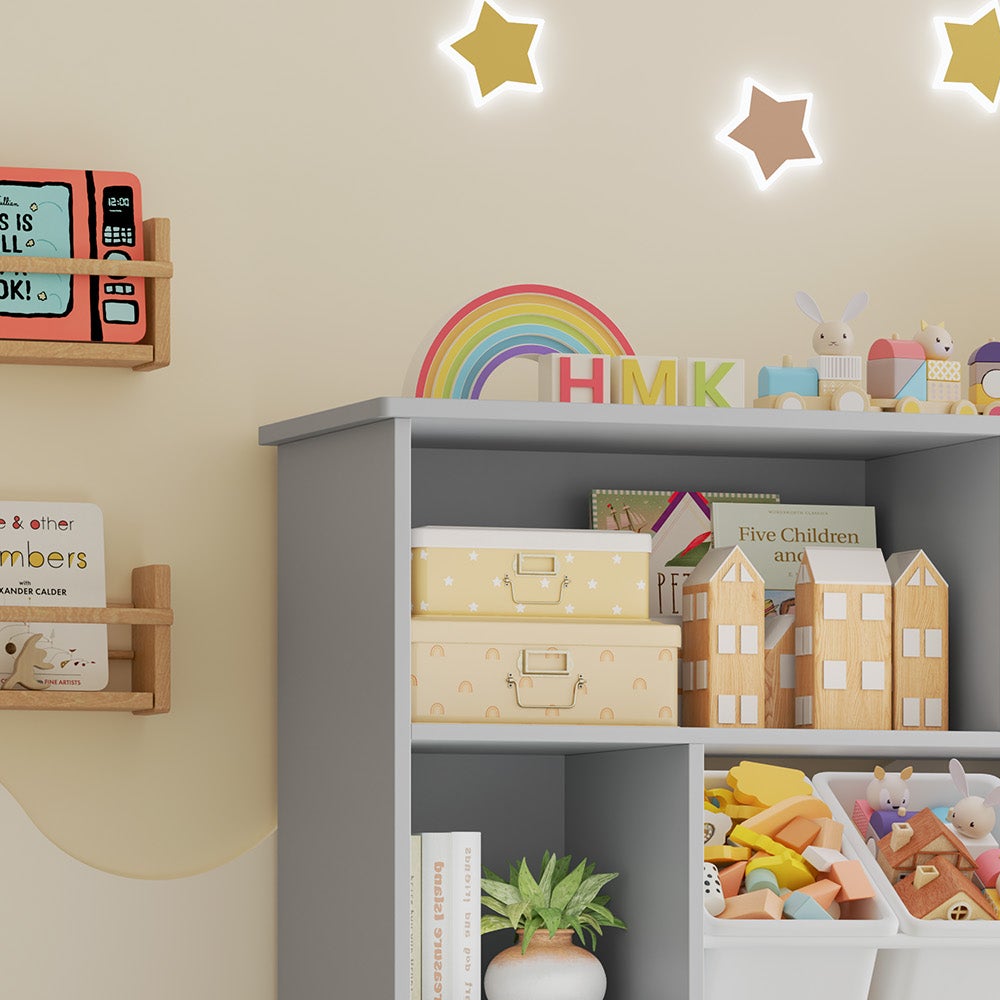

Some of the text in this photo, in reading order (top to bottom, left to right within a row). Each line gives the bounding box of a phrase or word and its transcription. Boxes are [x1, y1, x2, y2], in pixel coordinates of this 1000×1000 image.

[107, 197, 130, 207] 12:00
[16, 213, 33, 232] IS
[12, 515, 24, 530] &
[30, 516, 75, 531] other
[739, 526, 860, 544] Five Children
[35, 588, 68, 596] CALDER
